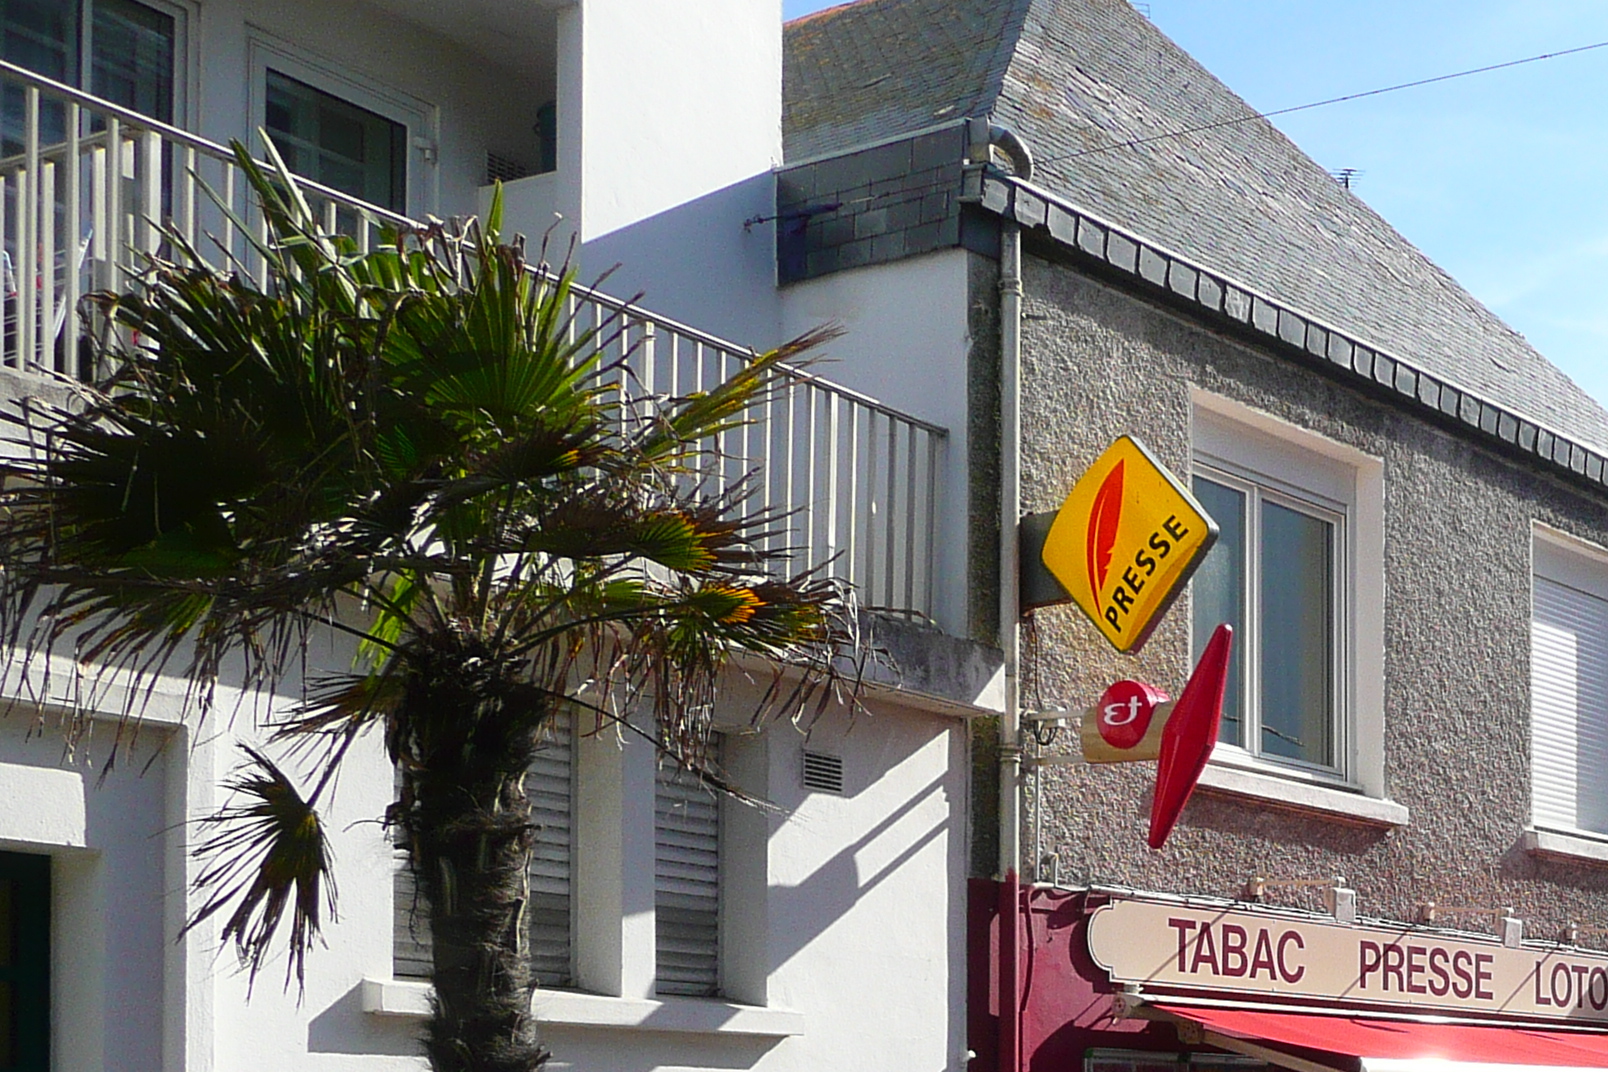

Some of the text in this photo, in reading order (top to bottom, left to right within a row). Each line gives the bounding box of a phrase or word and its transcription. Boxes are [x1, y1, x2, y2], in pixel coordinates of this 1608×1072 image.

[1105, 515, 1189, 633] PRESSE
[1168, 917, 1608, 1011] TABAC PRESSE LOTO
